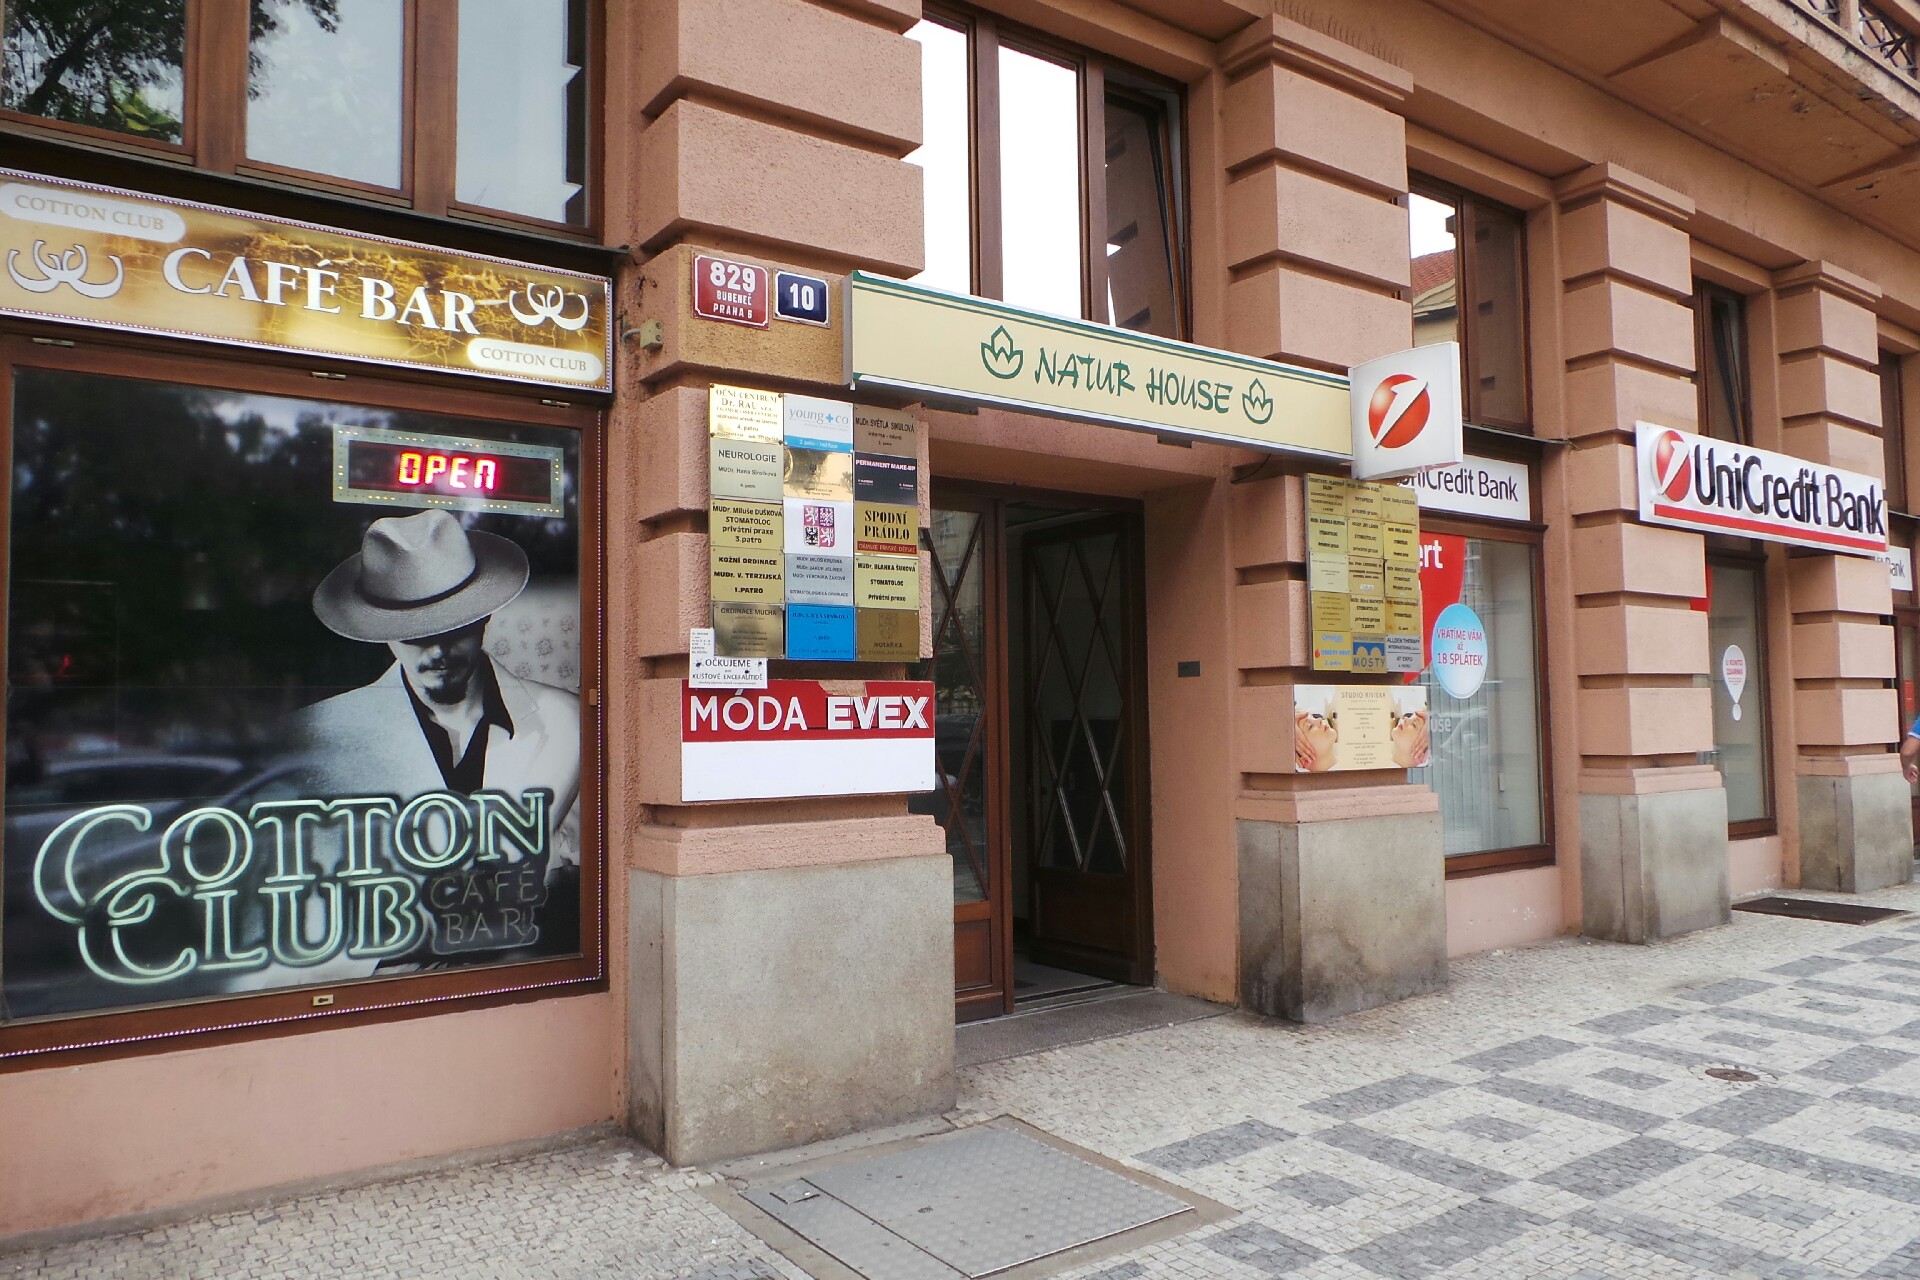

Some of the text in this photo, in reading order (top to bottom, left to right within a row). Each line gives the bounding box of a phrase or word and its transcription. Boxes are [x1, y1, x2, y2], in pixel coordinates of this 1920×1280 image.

[14, 194, 165, 232] COTTON CLUB
[710, 261, 756, 293] 829
[161, 246, 482, 336] CAFÉ BAR
[716, 290, 752, 306] BUBENEČ
[790, 282, 815, 311] 10
[713, 303, 753, 319] PRAHA 6
[479, 346, 588, 372] COTTON CLUB
[1034, 347, 1234, 414] NATUR HOUSE
[721, 397, 735, 406] Dr.
[718, 449, 777, 463] NEUROLOGIE
[855, 459, 890, 469] PERMANENT
[398, 452, 498, 491] OPEN
[1479, 470, 1518, 501] Bank
[1694, 443, 1886, 536] UniCredit Bank
[732, 507, 754, 515] Miluše
[864, 510, 908, 525] SPODNÍ
[725, 516, 771, 526] STOMATOLOG
[722, 526, 752, 534] privátní
[864, 524, 910, 540] PRÁDLO
[718, 555, 778, 566] KOŽNÍ ORDINACE
[873, 563, 895, 571] BLANKA
[870, 578, 904, 587] STOMATOLOG
[720, 607, 753, 615] ORDINACE
[1436, 627, 1483, 642] VRÁTÍME VÁM
[1457, 641, 1464, 651] až
[705, 656, 751, 668] OČKUJEME
[1352, 657, 1385, 668] MOSTY
[1437, 650, 1483, 667] 18 SPLÁTEK
[690, 688, 930, 731] MÓDA EVEX
[34, 791, 546, 926] COTTON
[78, 874, 424, 984] CLUB
[443, 904, 536, 946] BAR
